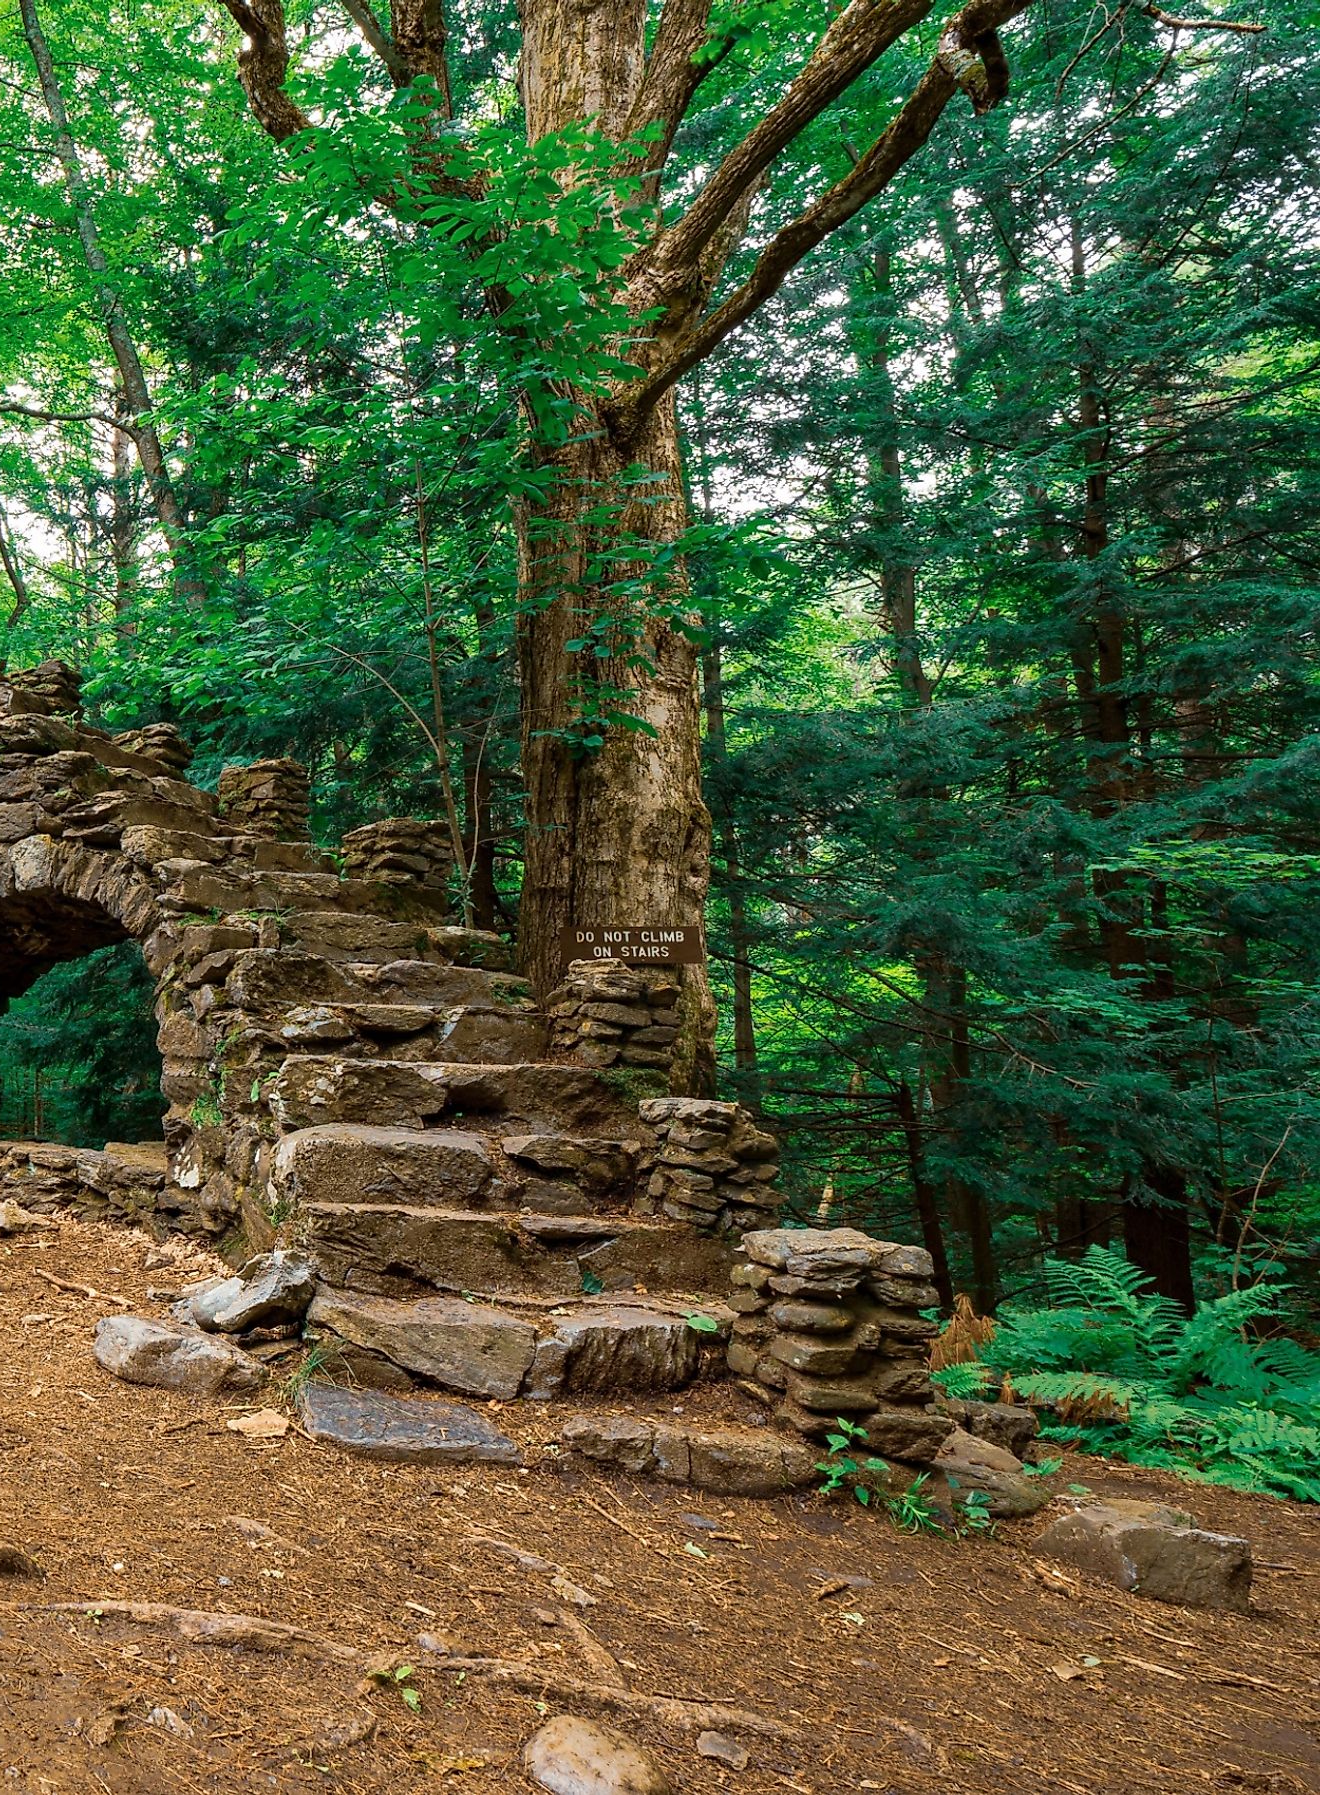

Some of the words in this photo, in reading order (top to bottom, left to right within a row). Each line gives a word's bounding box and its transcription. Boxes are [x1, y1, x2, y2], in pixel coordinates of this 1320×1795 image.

[576, 931, 595, 943] DO
[603, 931, 631, 942] NOT
[641, 930, 685, 942] CLIMB
[593, 946, 612, 957] ON
[621, 946, 669, 957] STAIRS
